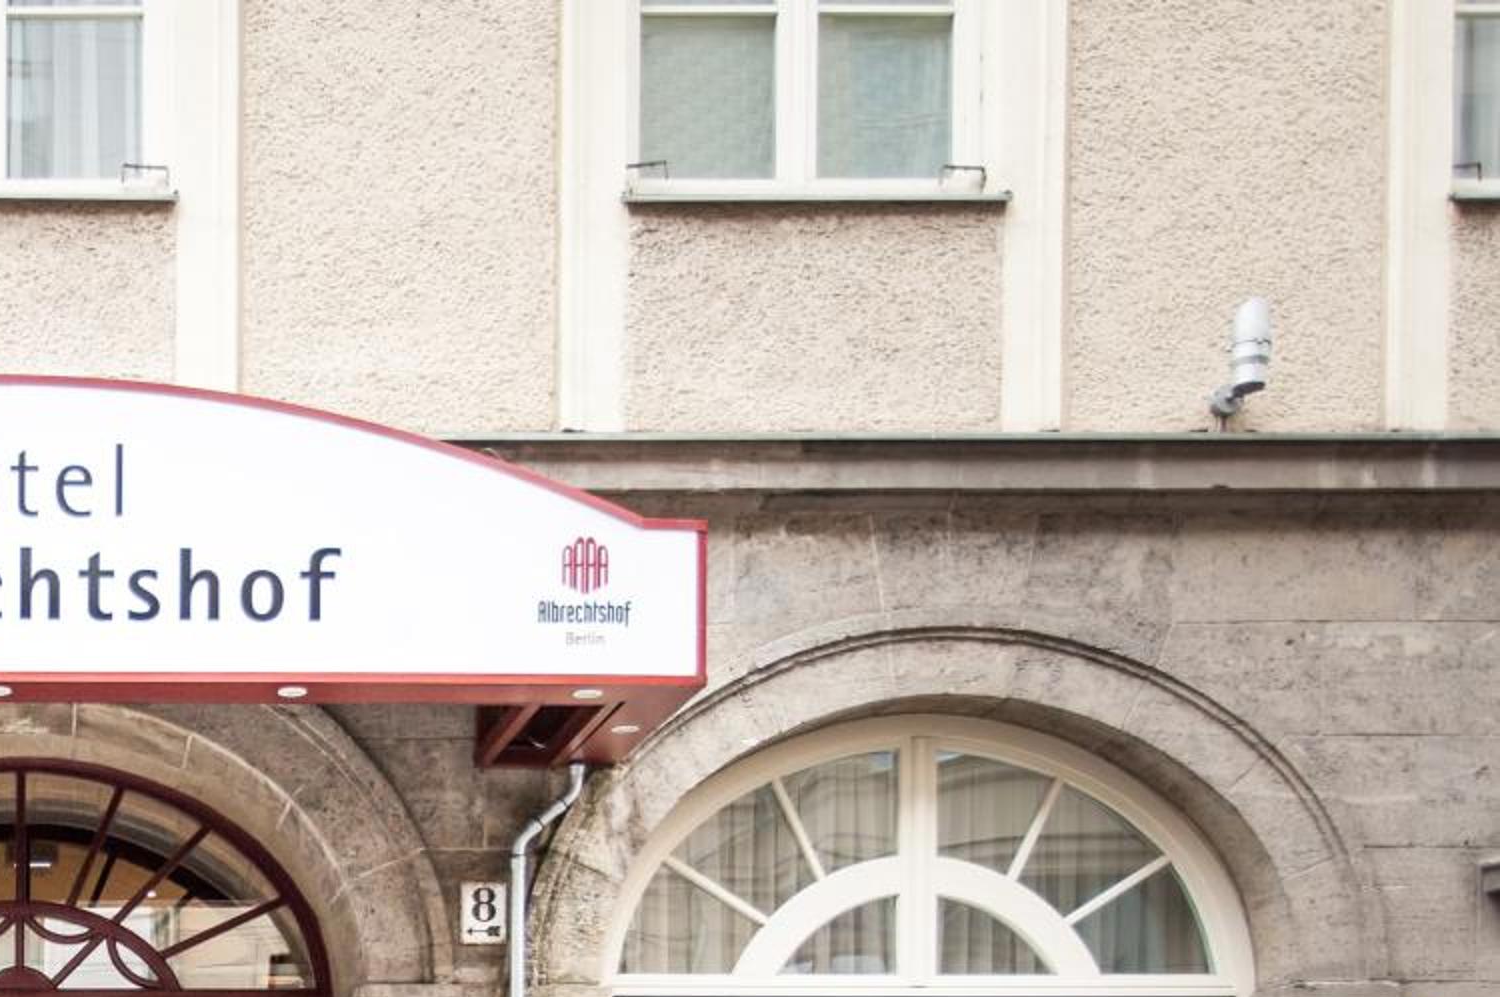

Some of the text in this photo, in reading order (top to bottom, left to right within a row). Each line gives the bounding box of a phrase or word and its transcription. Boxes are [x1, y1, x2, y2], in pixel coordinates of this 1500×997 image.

[537, 599, 633, 628] Albrechtshof
[565, 631, 606, 646] Berlin
[472, 887, 497, 922] 8
